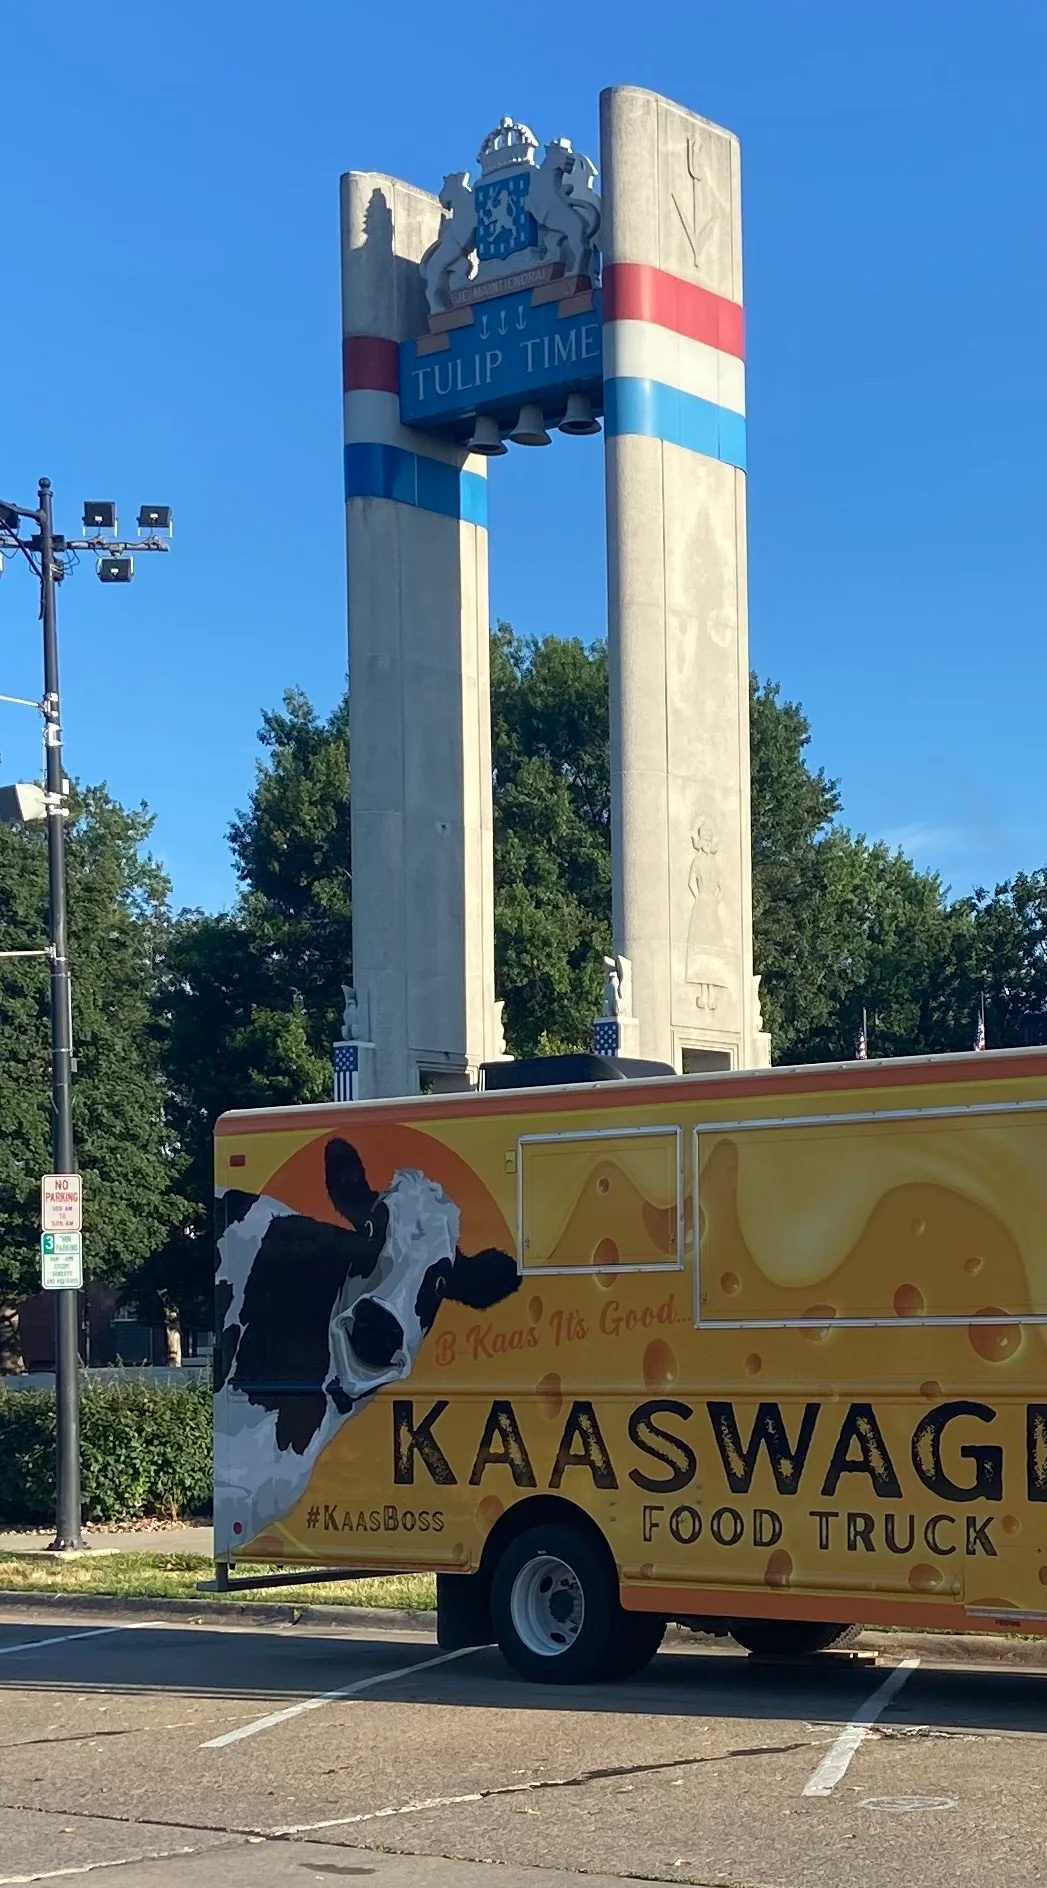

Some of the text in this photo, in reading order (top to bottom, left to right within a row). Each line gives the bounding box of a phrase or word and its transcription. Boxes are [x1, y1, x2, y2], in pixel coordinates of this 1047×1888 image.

[411, 323, 600, 401] TULIP TIME
[46, 1192, 78, 1202] PARKING
[55, 1180, 69, 1190] NO
[45, 1236, 54, 1249] 3
[434, 1293, 692, 1367] B-Kaas It's Good...
[642, 1504, 998, 1556] FOOD TRUCK
